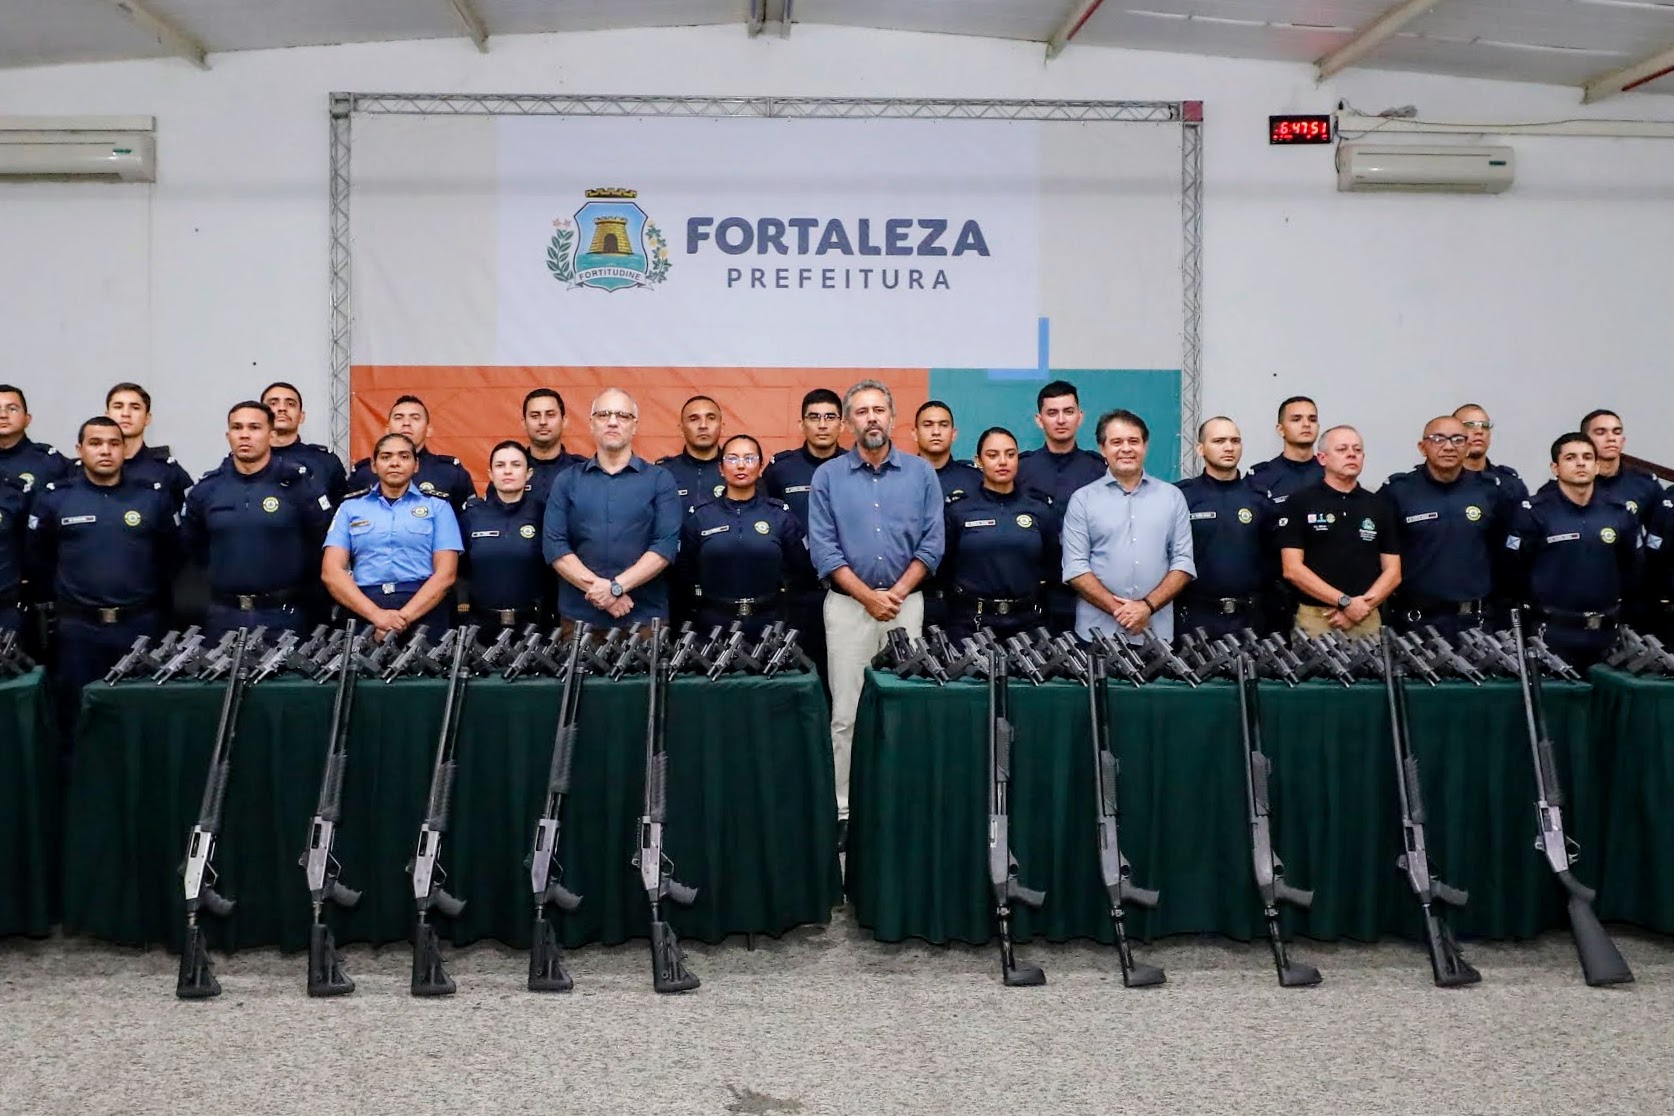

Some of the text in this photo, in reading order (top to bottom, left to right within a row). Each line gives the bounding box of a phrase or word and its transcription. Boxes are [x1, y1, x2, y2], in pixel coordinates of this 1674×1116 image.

[686, 216, 991, 256] FORTALEZA
[579, 268, 641, 281] FORTITUDINE
[727, 267, 950, 290] PREFEITURA
